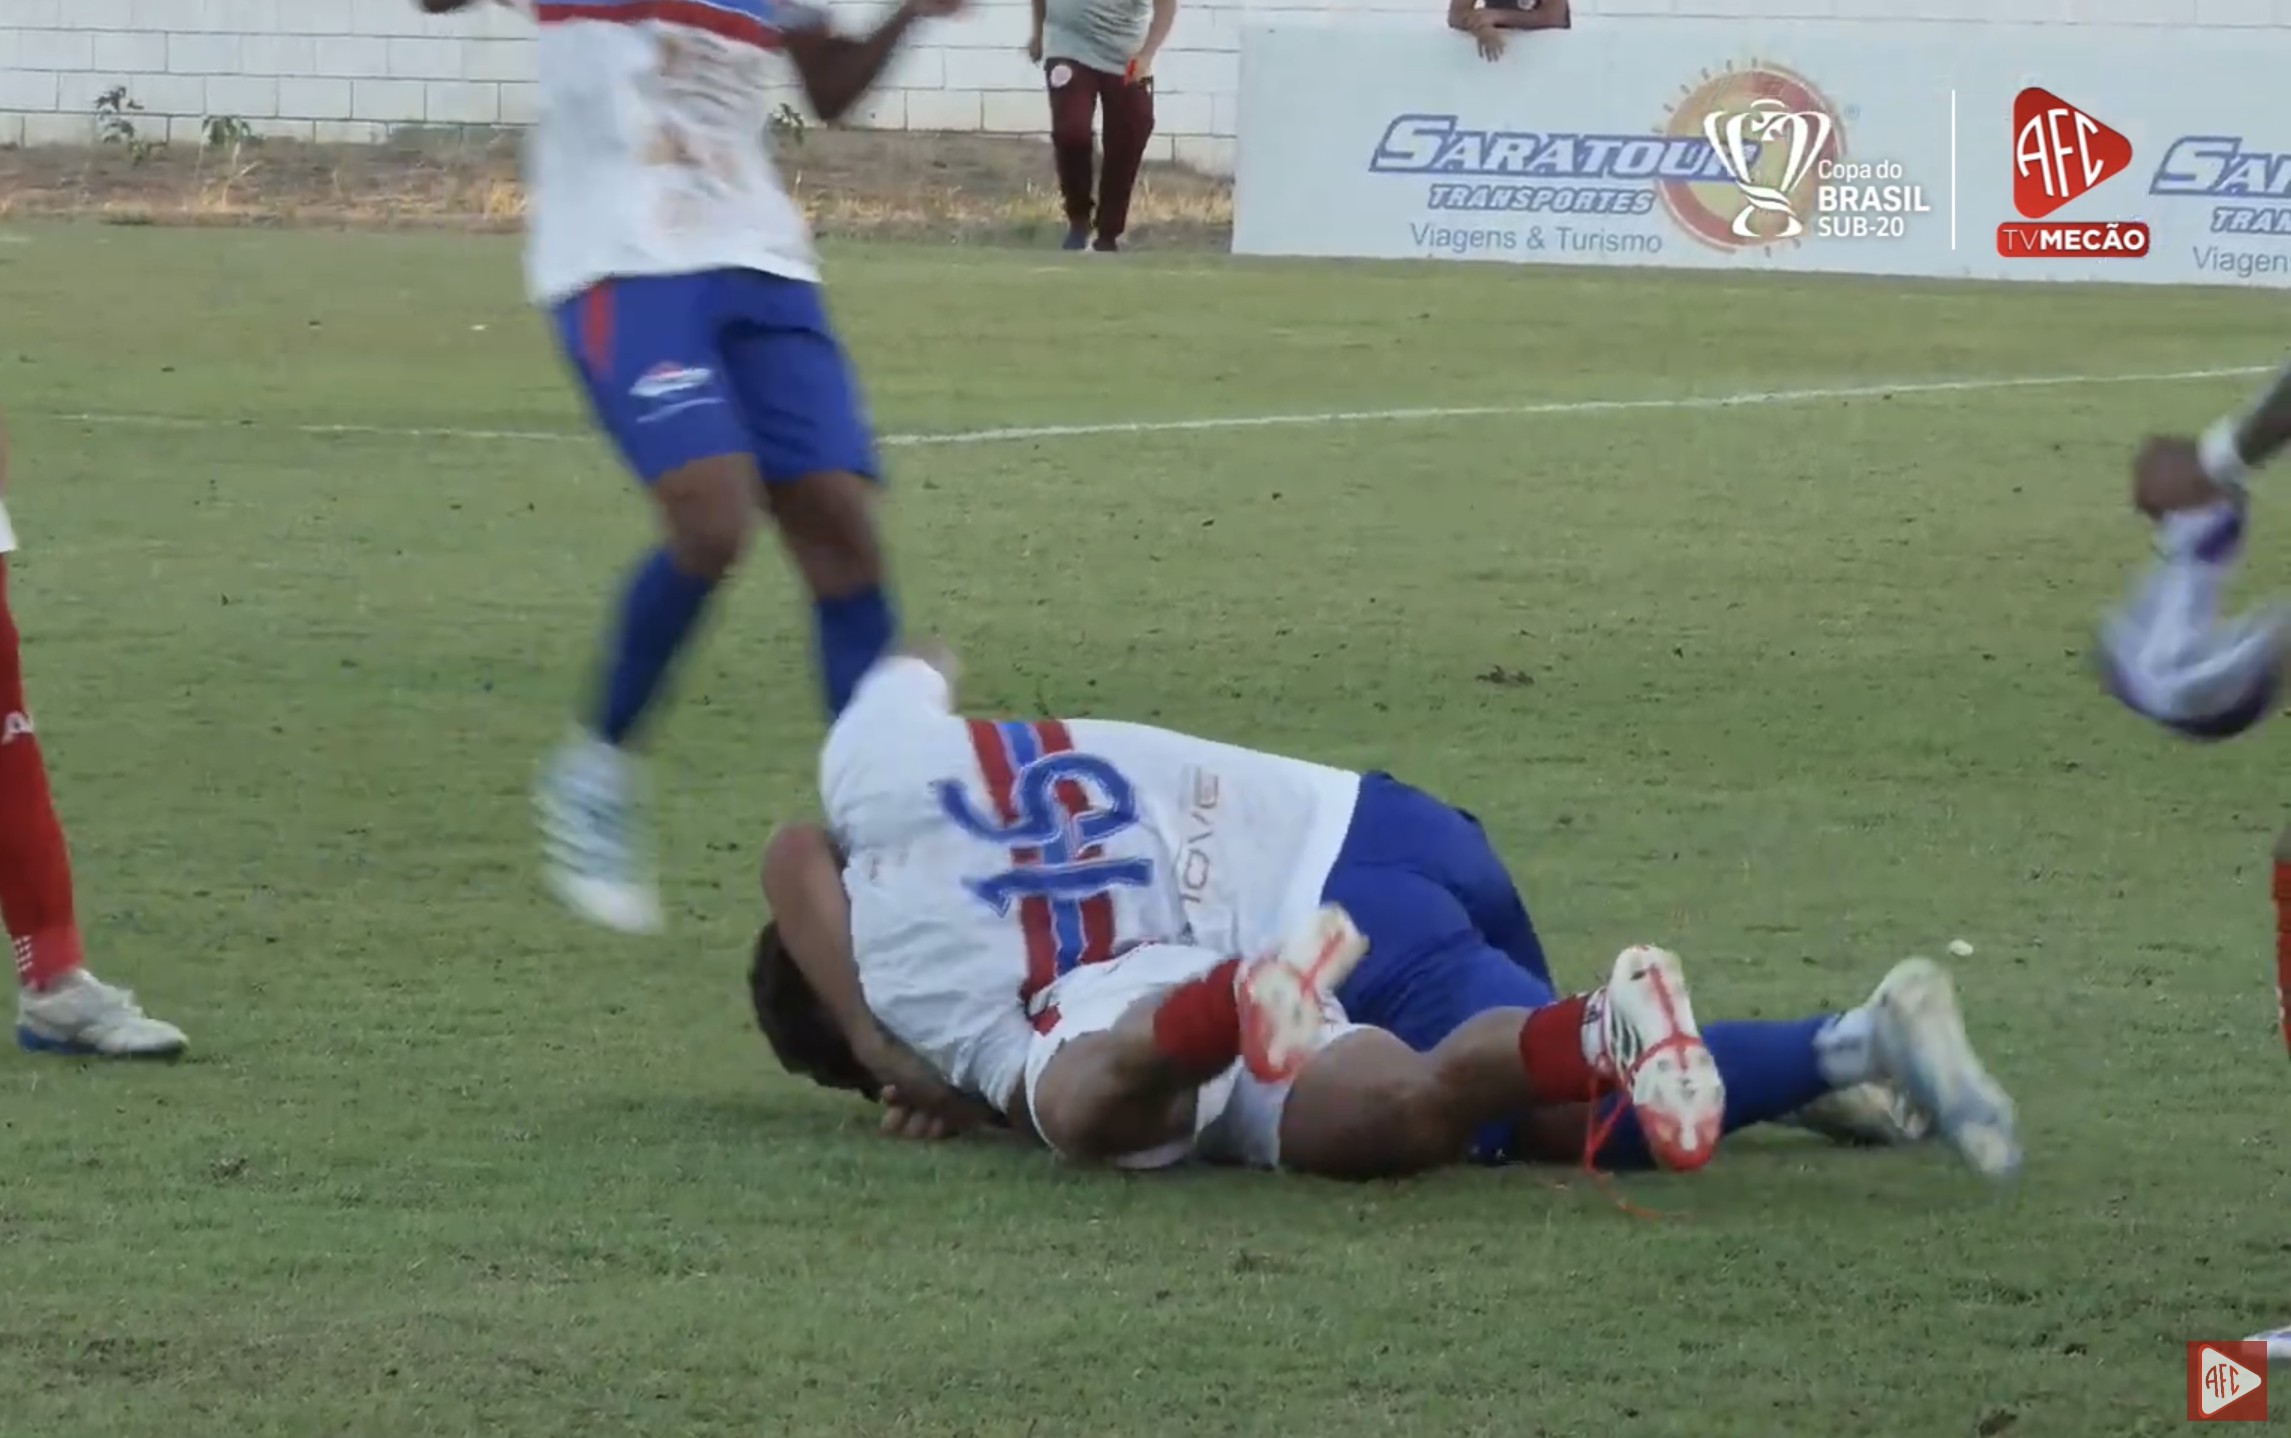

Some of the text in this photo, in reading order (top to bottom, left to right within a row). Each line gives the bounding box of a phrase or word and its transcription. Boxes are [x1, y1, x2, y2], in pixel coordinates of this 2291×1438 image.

[1428, 184, 1656, 214] TRANSPORTES
[1410, 223, 1662, 253] Viagens & Turismo
[930, 751, 1153, 918] 15
